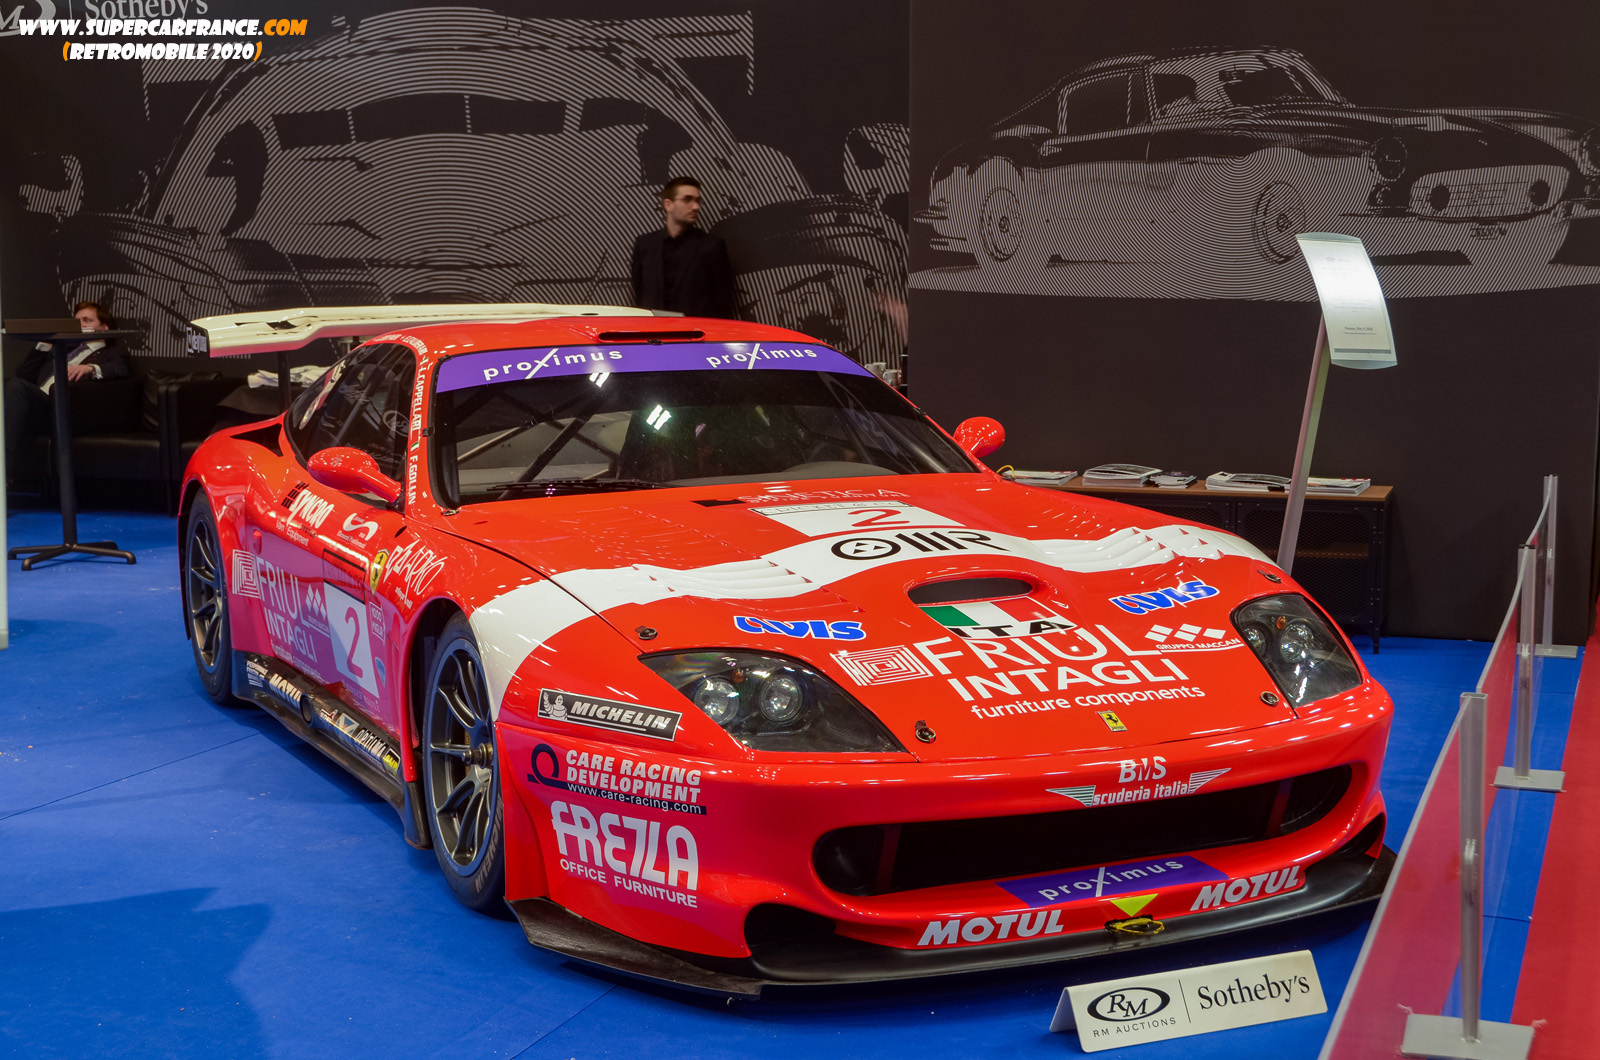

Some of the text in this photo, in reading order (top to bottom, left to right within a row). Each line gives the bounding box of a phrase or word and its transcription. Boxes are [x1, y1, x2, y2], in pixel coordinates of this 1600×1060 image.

[483, 348, 623, 381] proximus
[706, 343, 818, 370] proximus
[848, 509, 911, 528] 2
[256, 556, 311, 628] FRIUL
[264, 607, 318, 663] INTAGLI
[344, 606, 364, 678] 2
[947, 621, 1075, 639] ITA
[1196, 638, 1241, 649] MACCAN
[914, 623, 1163, 676] FRIUL
[947, 658, 1190, 702] INTAGLI
[570, 701, 672, 731] MICHELIN
[971, 685, 1205, 720] furniture components
[566, 749, 701, 786] CARE RACING
[567, 767, 701, 803] DEVELOPMENT
[567, 783, 701, 815] www.care-racing.com
[1092, 780, 1190, 806] scuderia italia
[560, 858, 698, 909] OFFICE FURNITURE
[1038, 858, 1184, 900] proximus
[1190, 865, 1301, 911] MOTUL
[917, 909, 1064, 946] MOTUL
[1106, 993, 1149, 1018] RM
[1197, 973, 1311, 1010] Sotheby's
[1093, 1017, 1176, 1038] RM AUCTIONS
